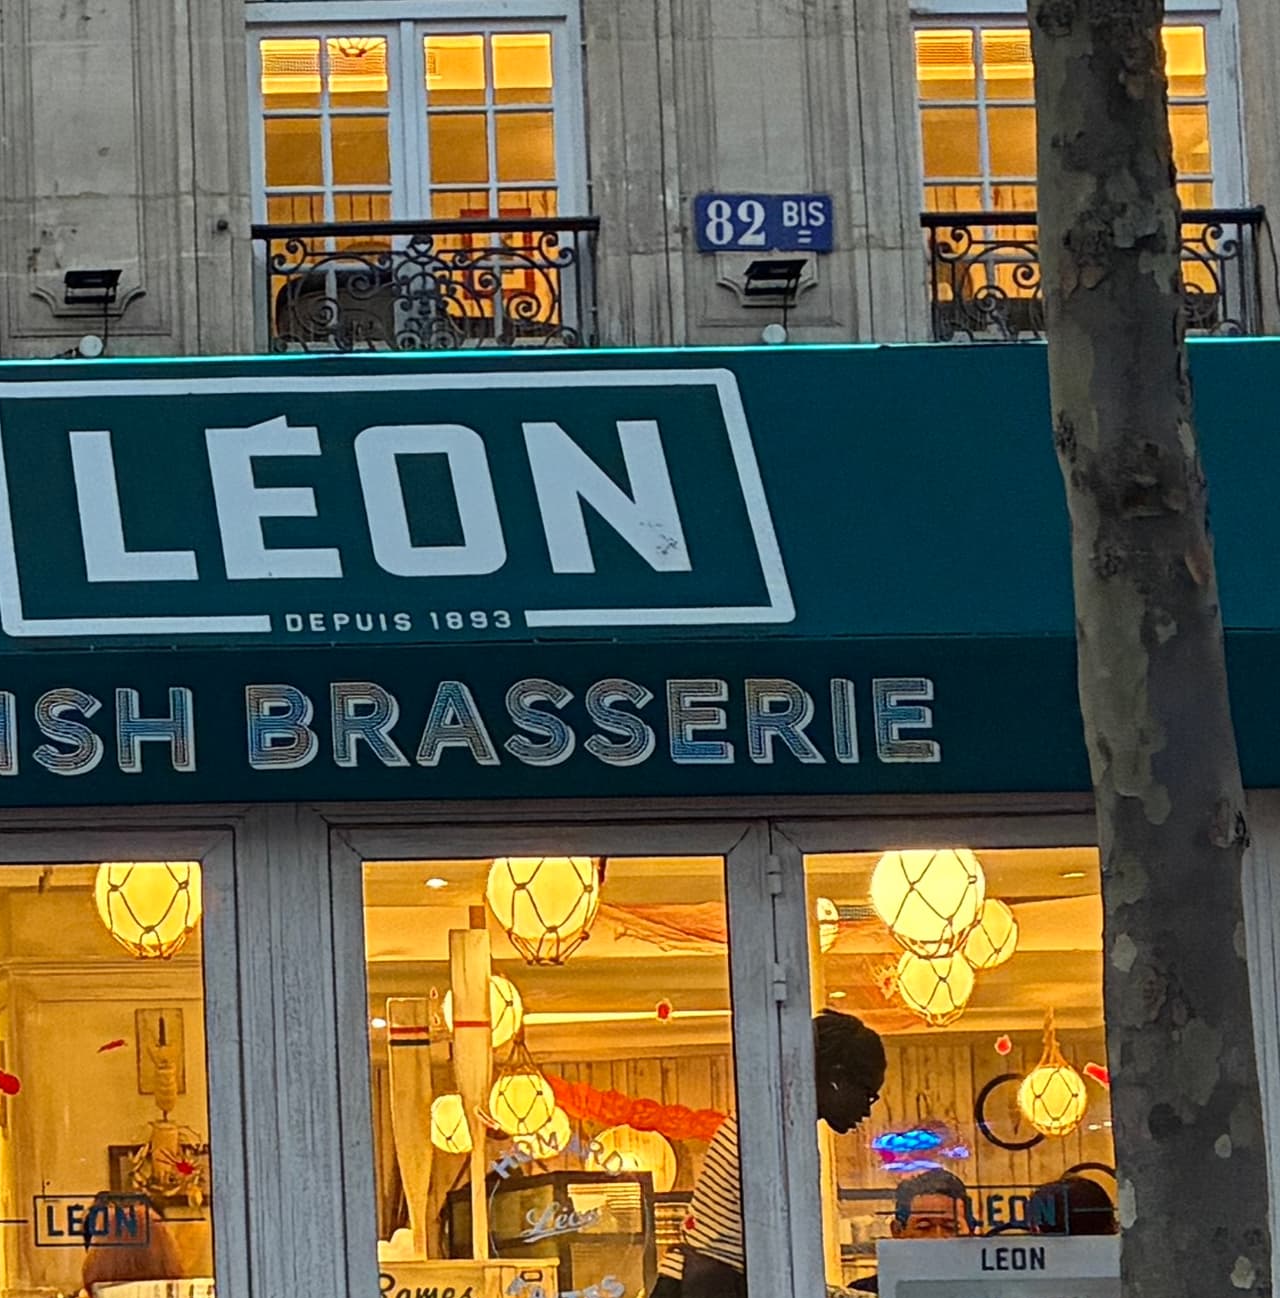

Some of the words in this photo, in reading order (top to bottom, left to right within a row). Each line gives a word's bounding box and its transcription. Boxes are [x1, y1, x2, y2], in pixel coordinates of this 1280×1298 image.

[705, 199, 766, 246] 82
[782, 201, 826, 228] BIS
[285, 611, 413, 633] DEPUIS
[429, 609, 512, 630] 1893
[244, 676, 941, 771] BRASSERIE
